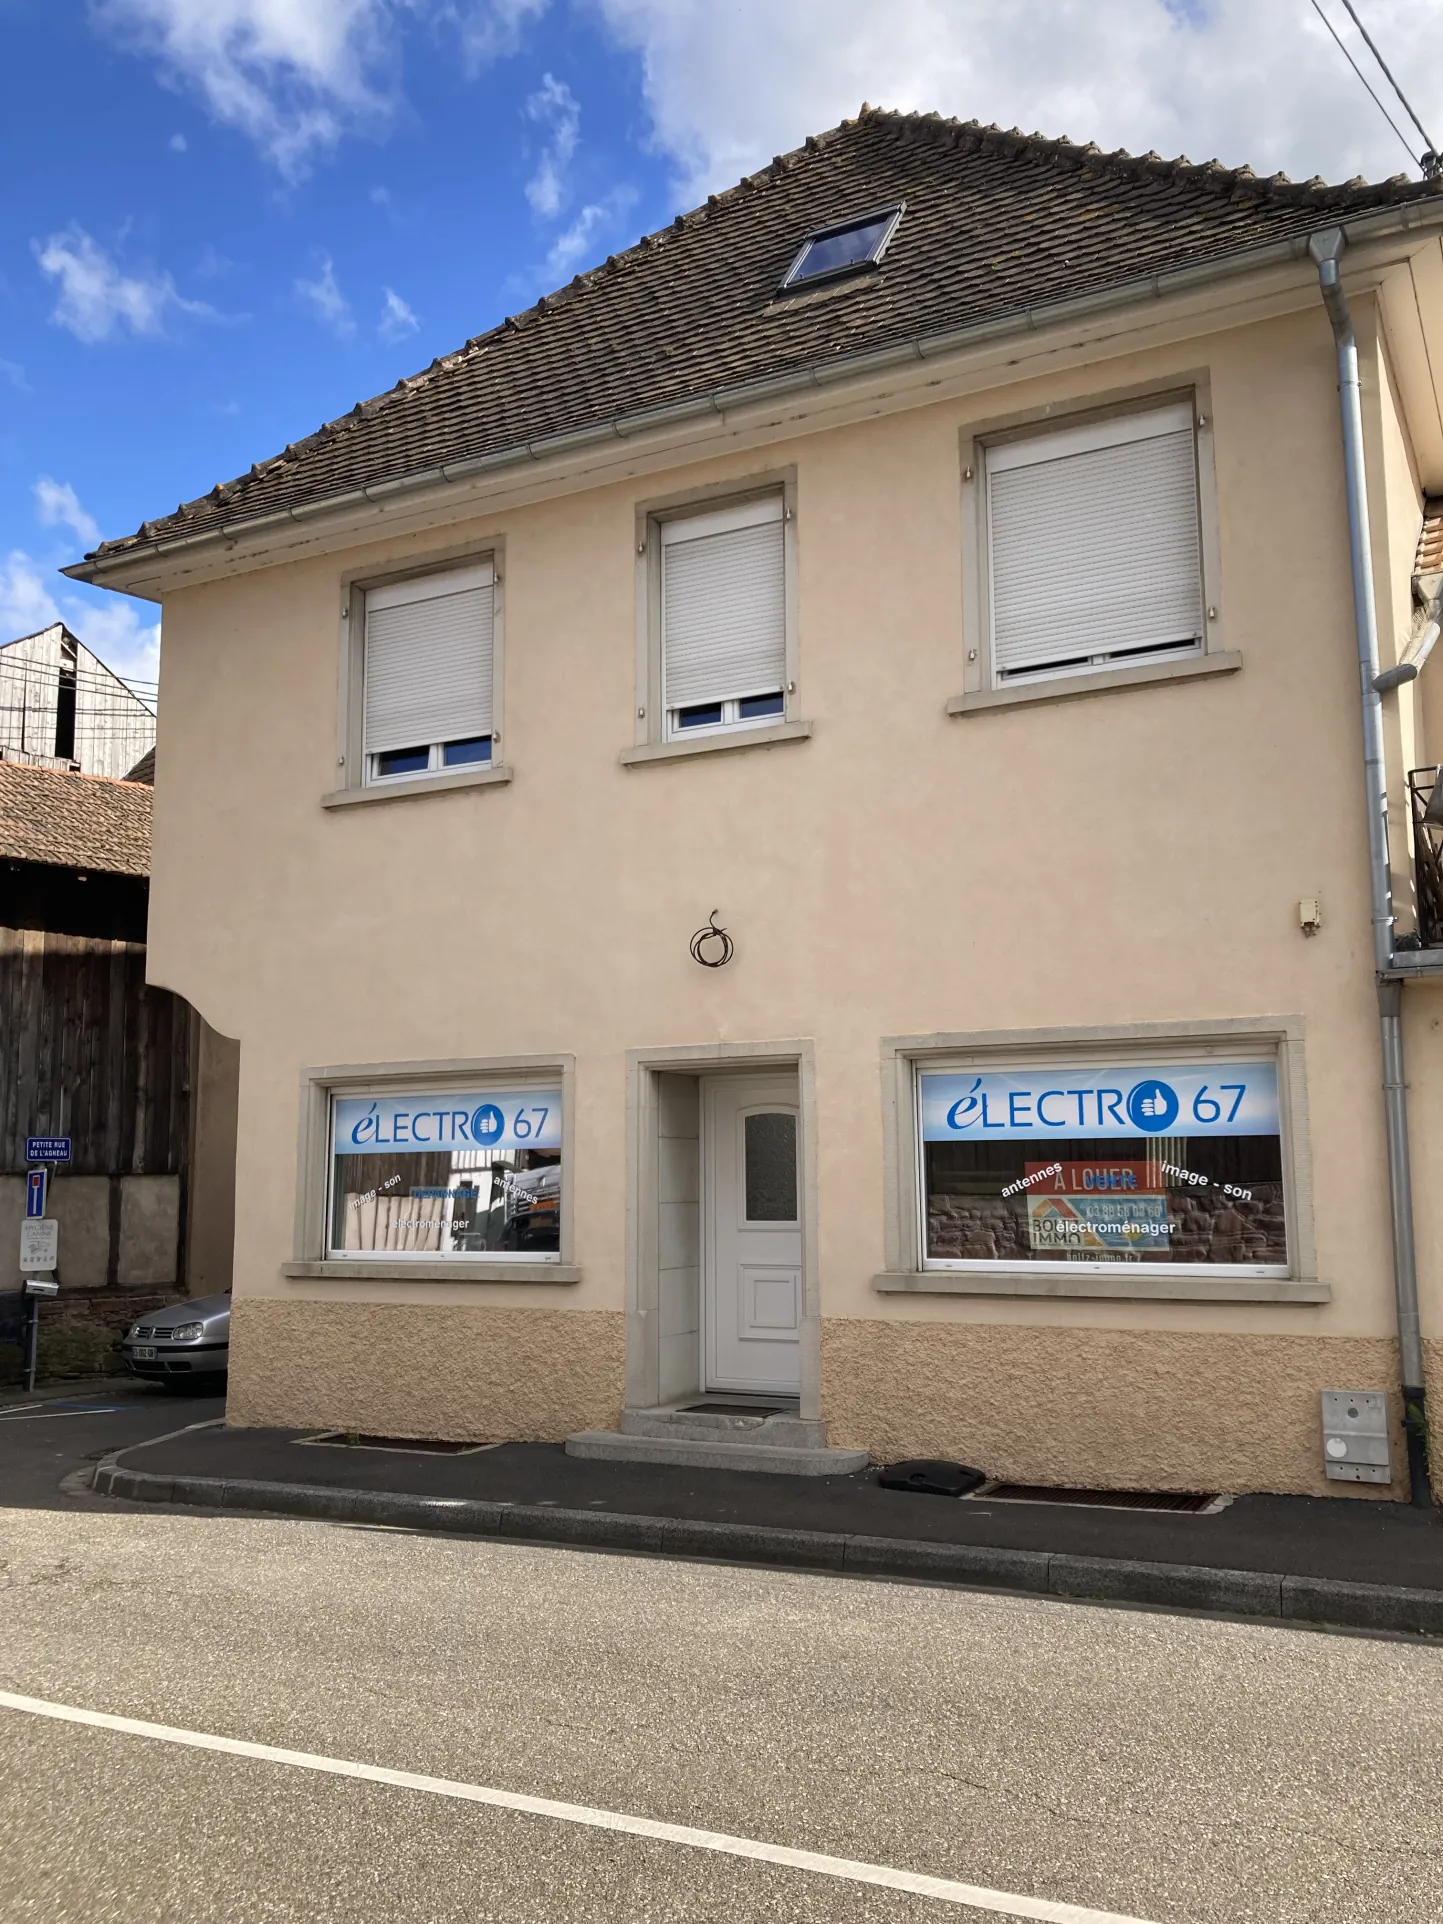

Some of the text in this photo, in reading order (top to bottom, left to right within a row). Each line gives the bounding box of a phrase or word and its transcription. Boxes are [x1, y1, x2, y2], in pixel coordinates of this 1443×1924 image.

[1192, 1084, 1247, 1125] 67
[513, 1108, 549, 1140] 67
[30, 1149, 68, 1157] DE L'AGNEAU
[32, 1141, 66, 1149] PETITE RUE
[384, 1173, 402, 1190] son
[494, 1176, 539, 1205] antennes
[1001, 1162, 1063, 1198] antennes
[1071, 1168, 1136, 1191] LOUER
[1160, 1160, 1209, 1187] image
[1223, 1183, 1253, 1202] son
[1056, 1220, 1176, 1237] électroménager
